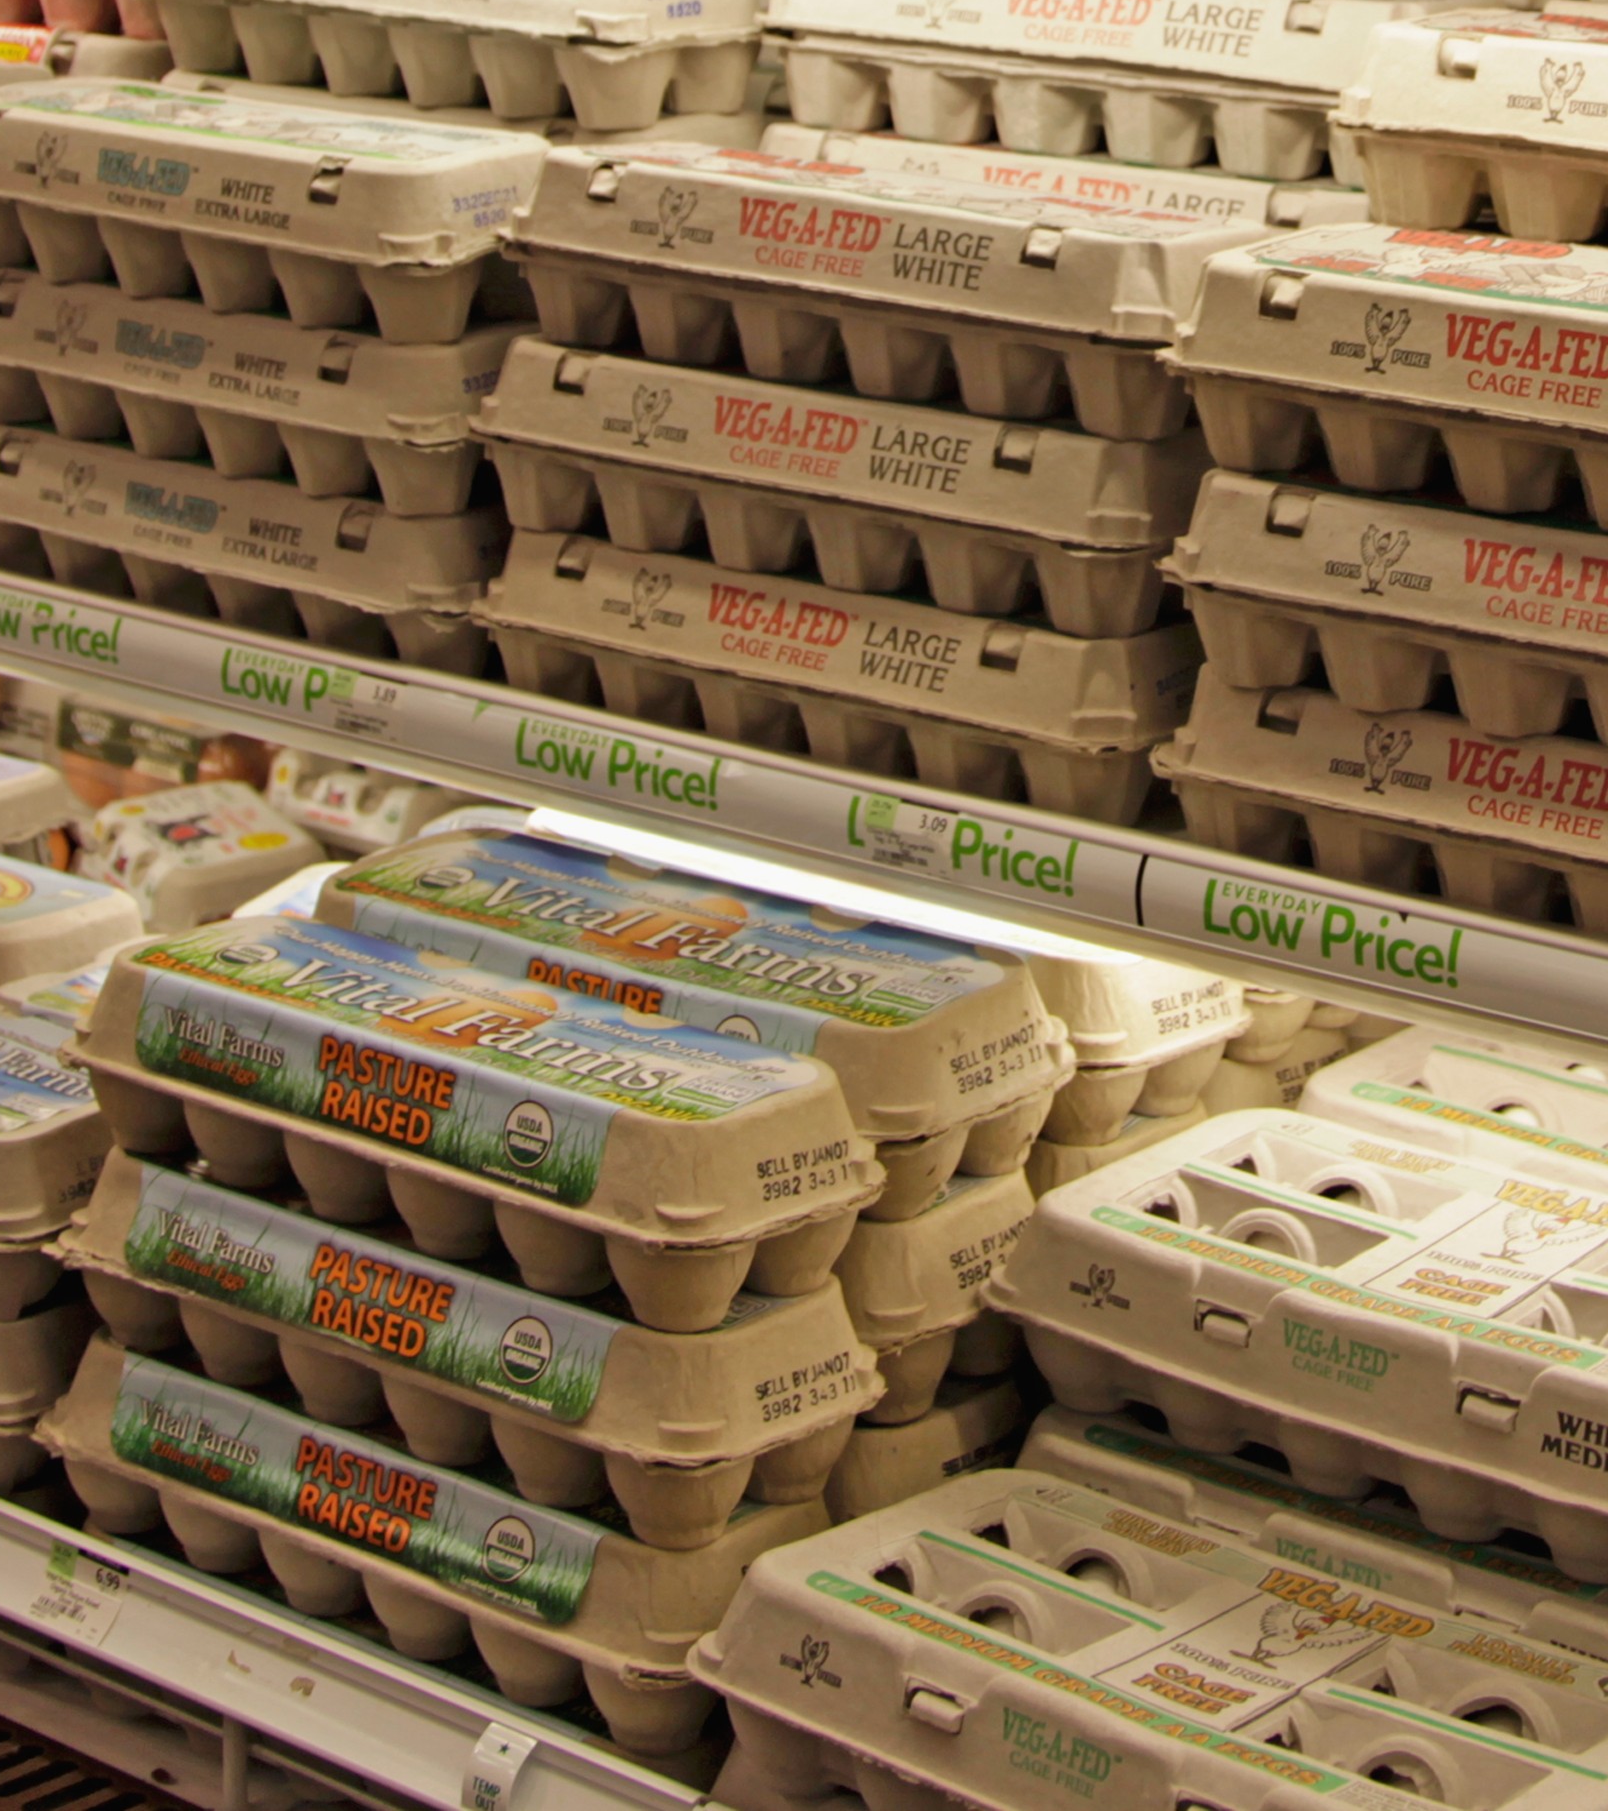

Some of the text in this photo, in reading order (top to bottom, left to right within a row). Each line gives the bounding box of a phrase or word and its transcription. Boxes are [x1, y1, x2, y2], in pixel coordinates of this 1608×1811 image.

[220, 177, 275, 204] WHITE
[194, 198, 290, 231] EXTRA LARGE
[1466, 369, 1601, 409] CAGE FREE
[32, 603, 121, 664] Price!
[918, 813, 948, 834] 3.09
[1222, 881, 1321, 917] EVERYDAY
[483, 875, 873, 1001] Vital Farms
[1203, 877, 1462, 988] Low Price!
[164, 1008, 284, 1068] Vital Farms
[318, 1036, 457, 1112] PASTURE
[321, 1080, 433, 1147] RAISED
[516, 1112, 543, 1135] USDA
[755, 1378, 789, 1402] SELL
[792, 1370, 810, 1391] BY
[762, 1397, 801, 1423] 3982
